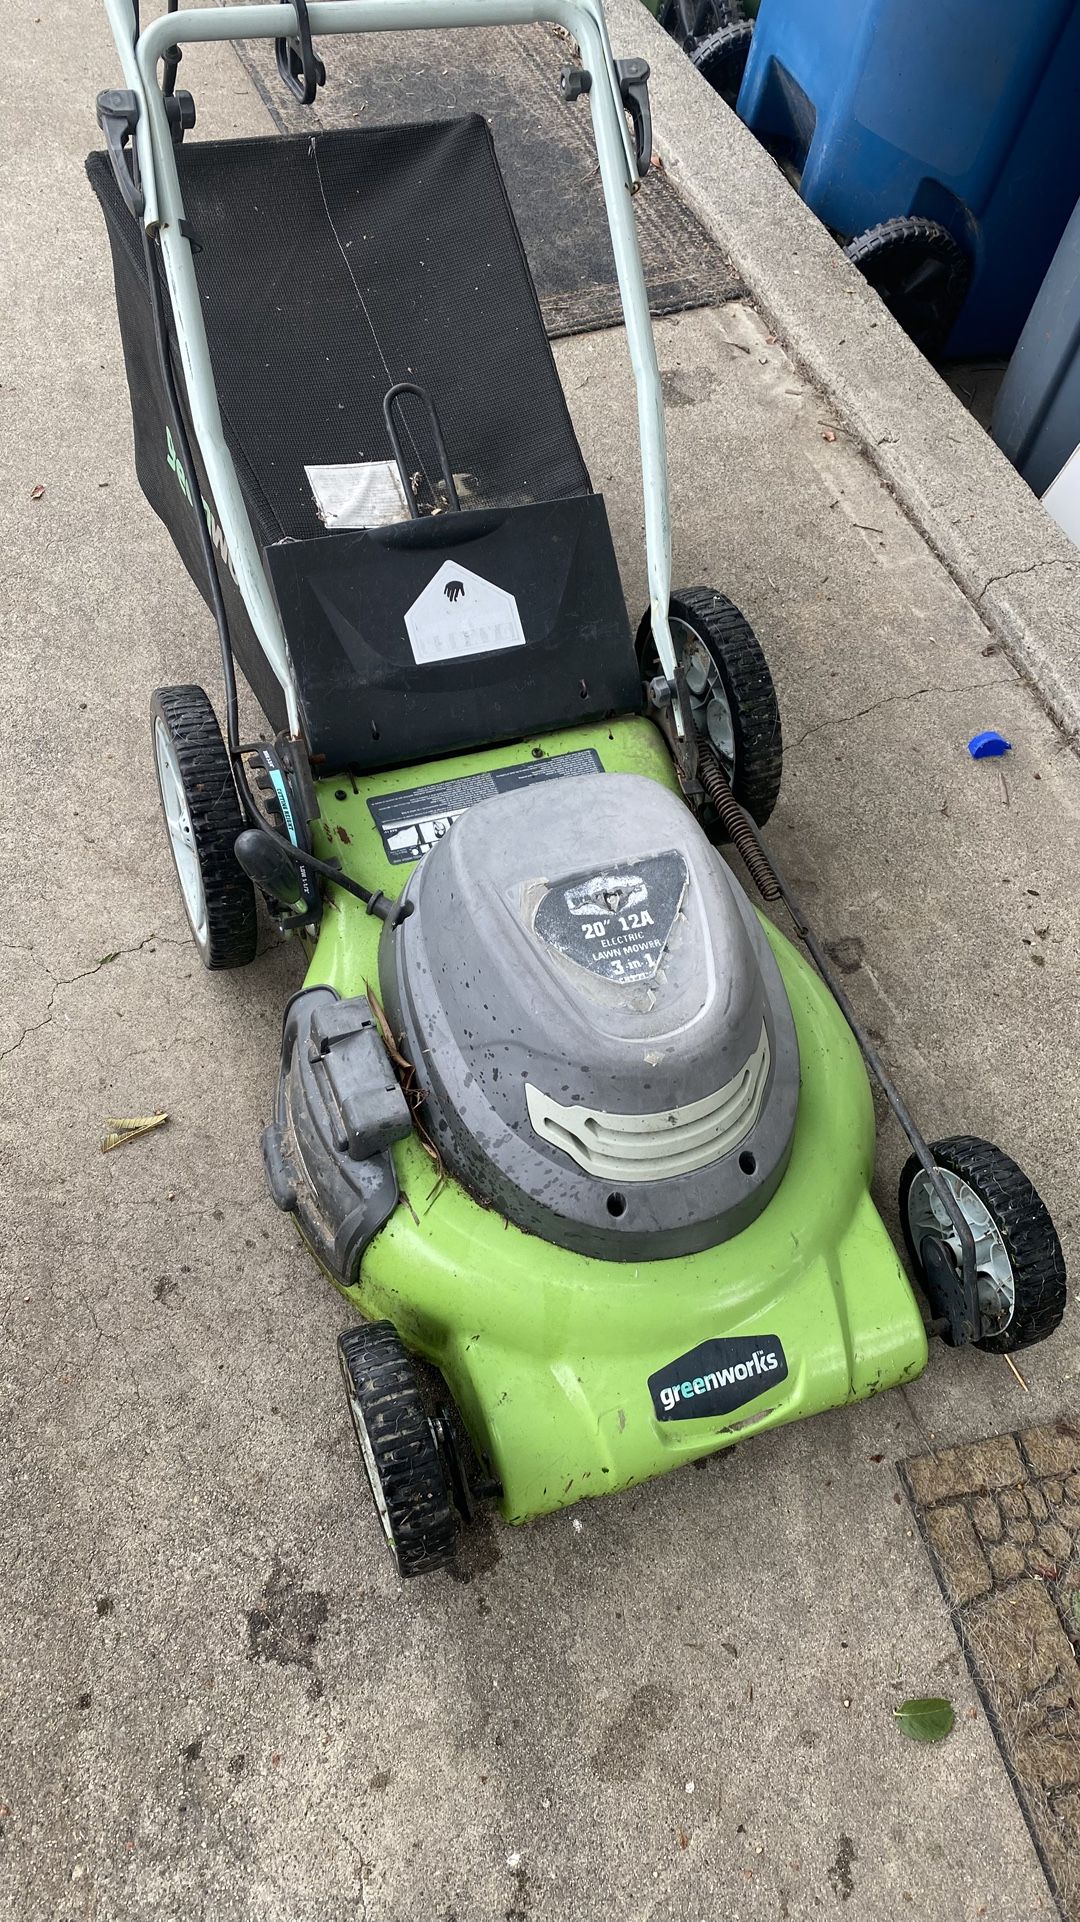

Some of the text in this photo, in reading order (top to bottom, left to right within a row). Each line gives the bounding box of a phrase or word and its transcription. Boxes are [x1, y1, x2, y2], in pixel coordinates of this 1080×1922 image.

[618, 909, 655, 932] 12A
[592, 938, 663, 961] LAWN MOWER
[600, 931, 645, 948] ELECTRIC
[659, 1351, 779, 1412] greenworks
